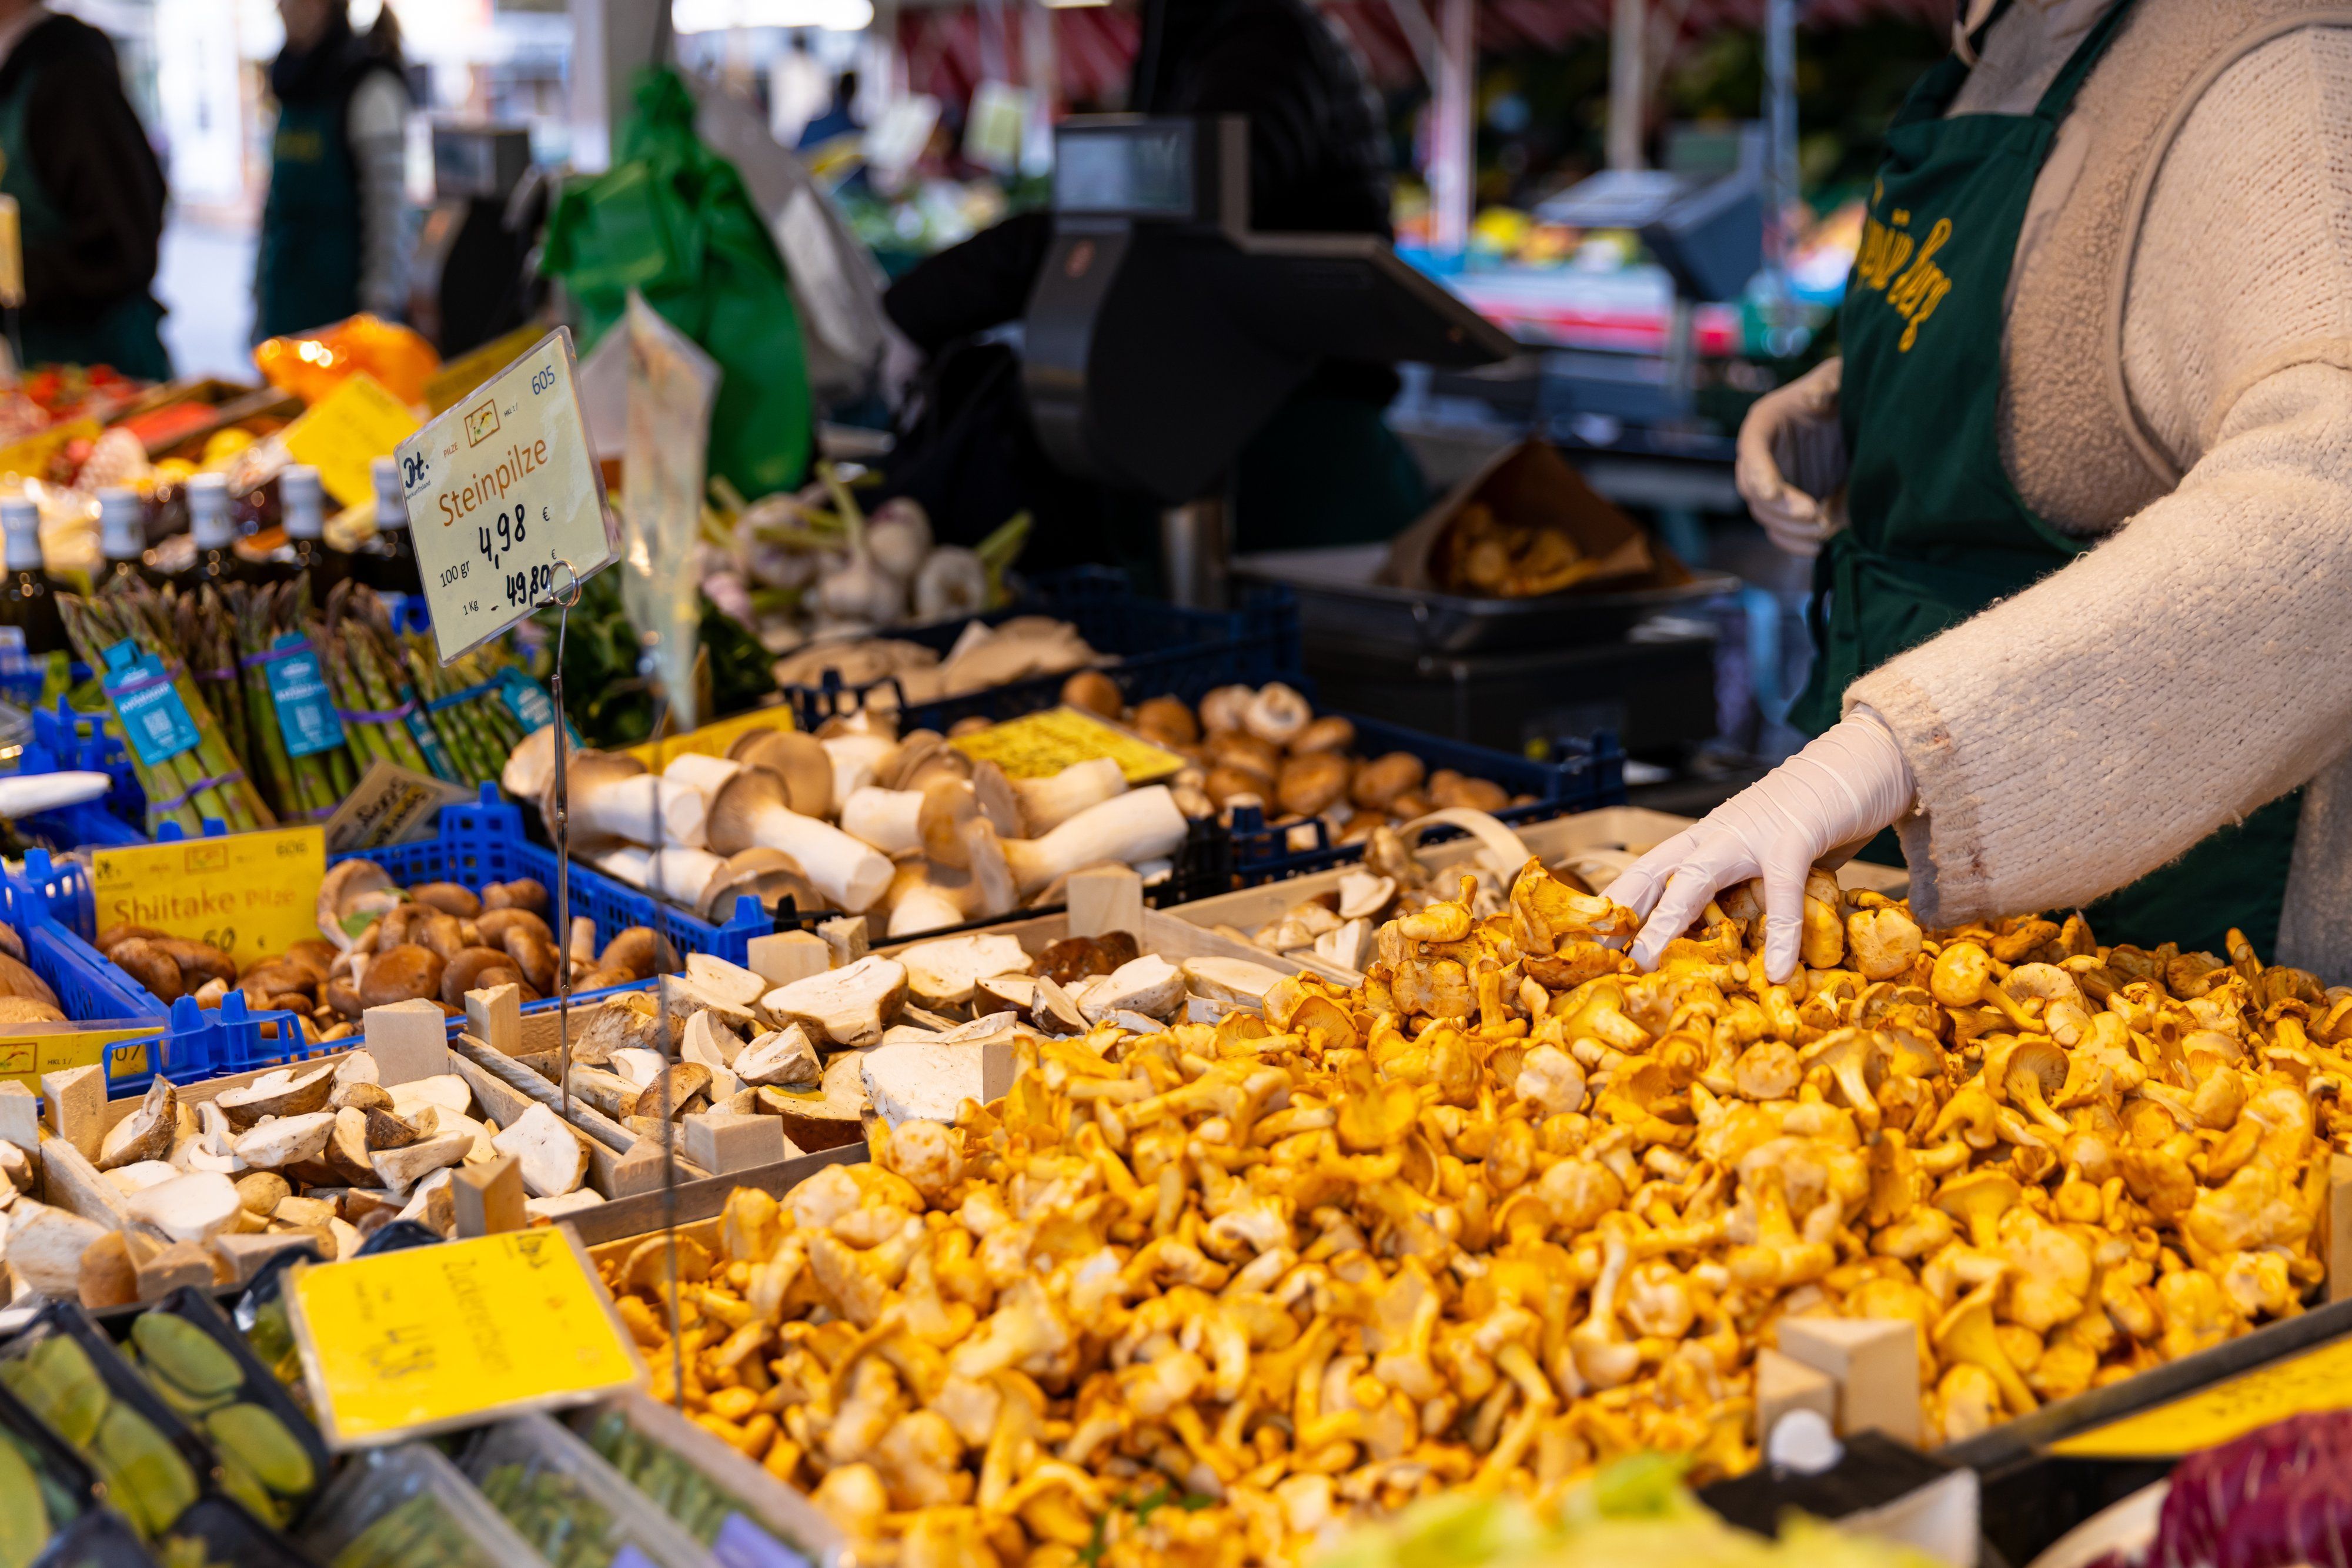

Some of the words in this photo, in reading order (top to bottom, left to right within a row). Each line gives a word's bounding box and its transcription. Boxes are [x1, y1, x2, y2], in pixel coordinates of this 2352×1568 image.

[532, 365, 555, 395] 605
[504, 408, 512, 417] HKL
[443, 442, 459, 458] PILZE
[439, 439, 548, 527] Steinpilze
[479, 503, 526, 570] 4,98
[542, 506, 550, 521] €
[551, 549, 557, 560] €
[440, 565, 459, 588] 100
[460, 560, 470, 579] gr
[506, 564, 550, 607] 49,80
[463, 605, 469, 616] 1
[469, 600, 479, 612] Kg
[113, 887, 235, 924] Shiitake
[245, 887, 296, 908] Pilze
